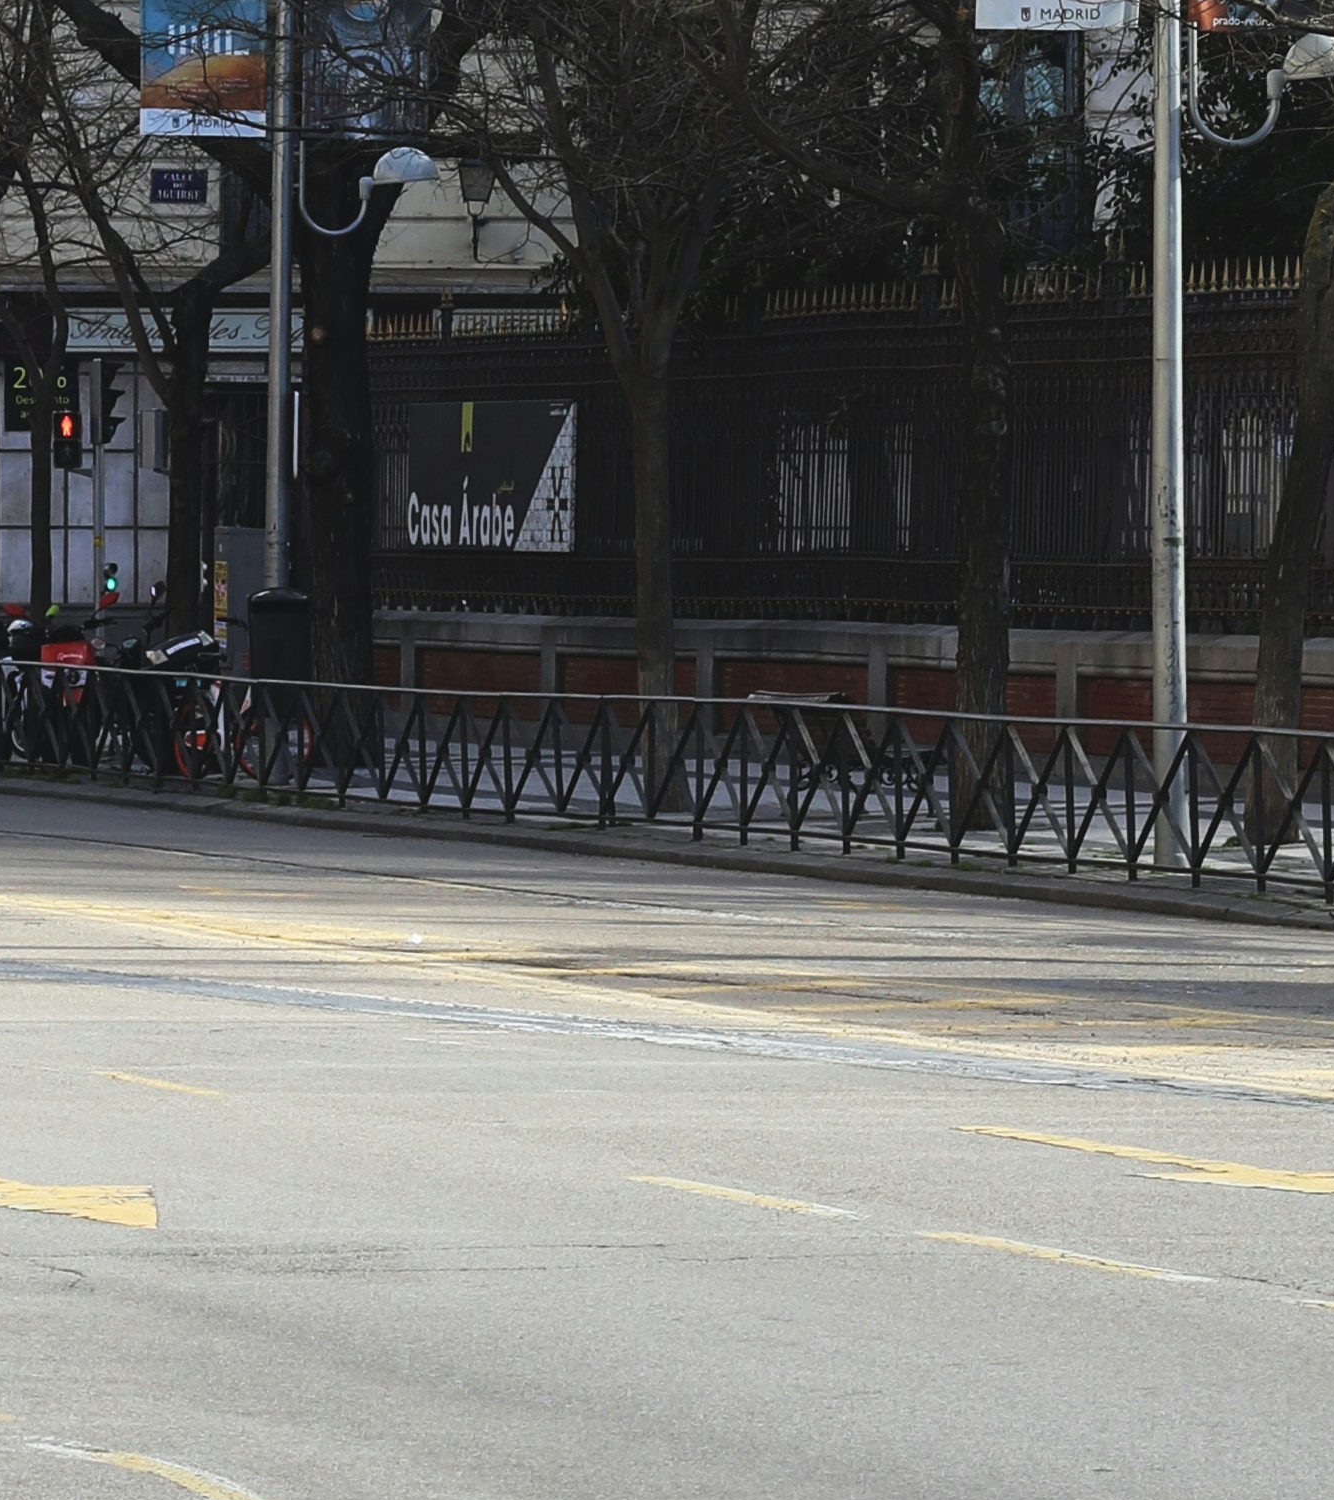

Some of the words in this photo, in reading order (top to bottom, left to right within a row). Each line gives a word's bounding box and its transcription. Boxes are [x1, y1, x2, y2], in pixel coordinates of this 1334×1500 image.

[1040, 7, 1101, 20] MADRID
[156, 189, 200, 200] AGUIRRE
[407, 491, 452, 546] Casa
[458, 475, 515, 547] Árabe
